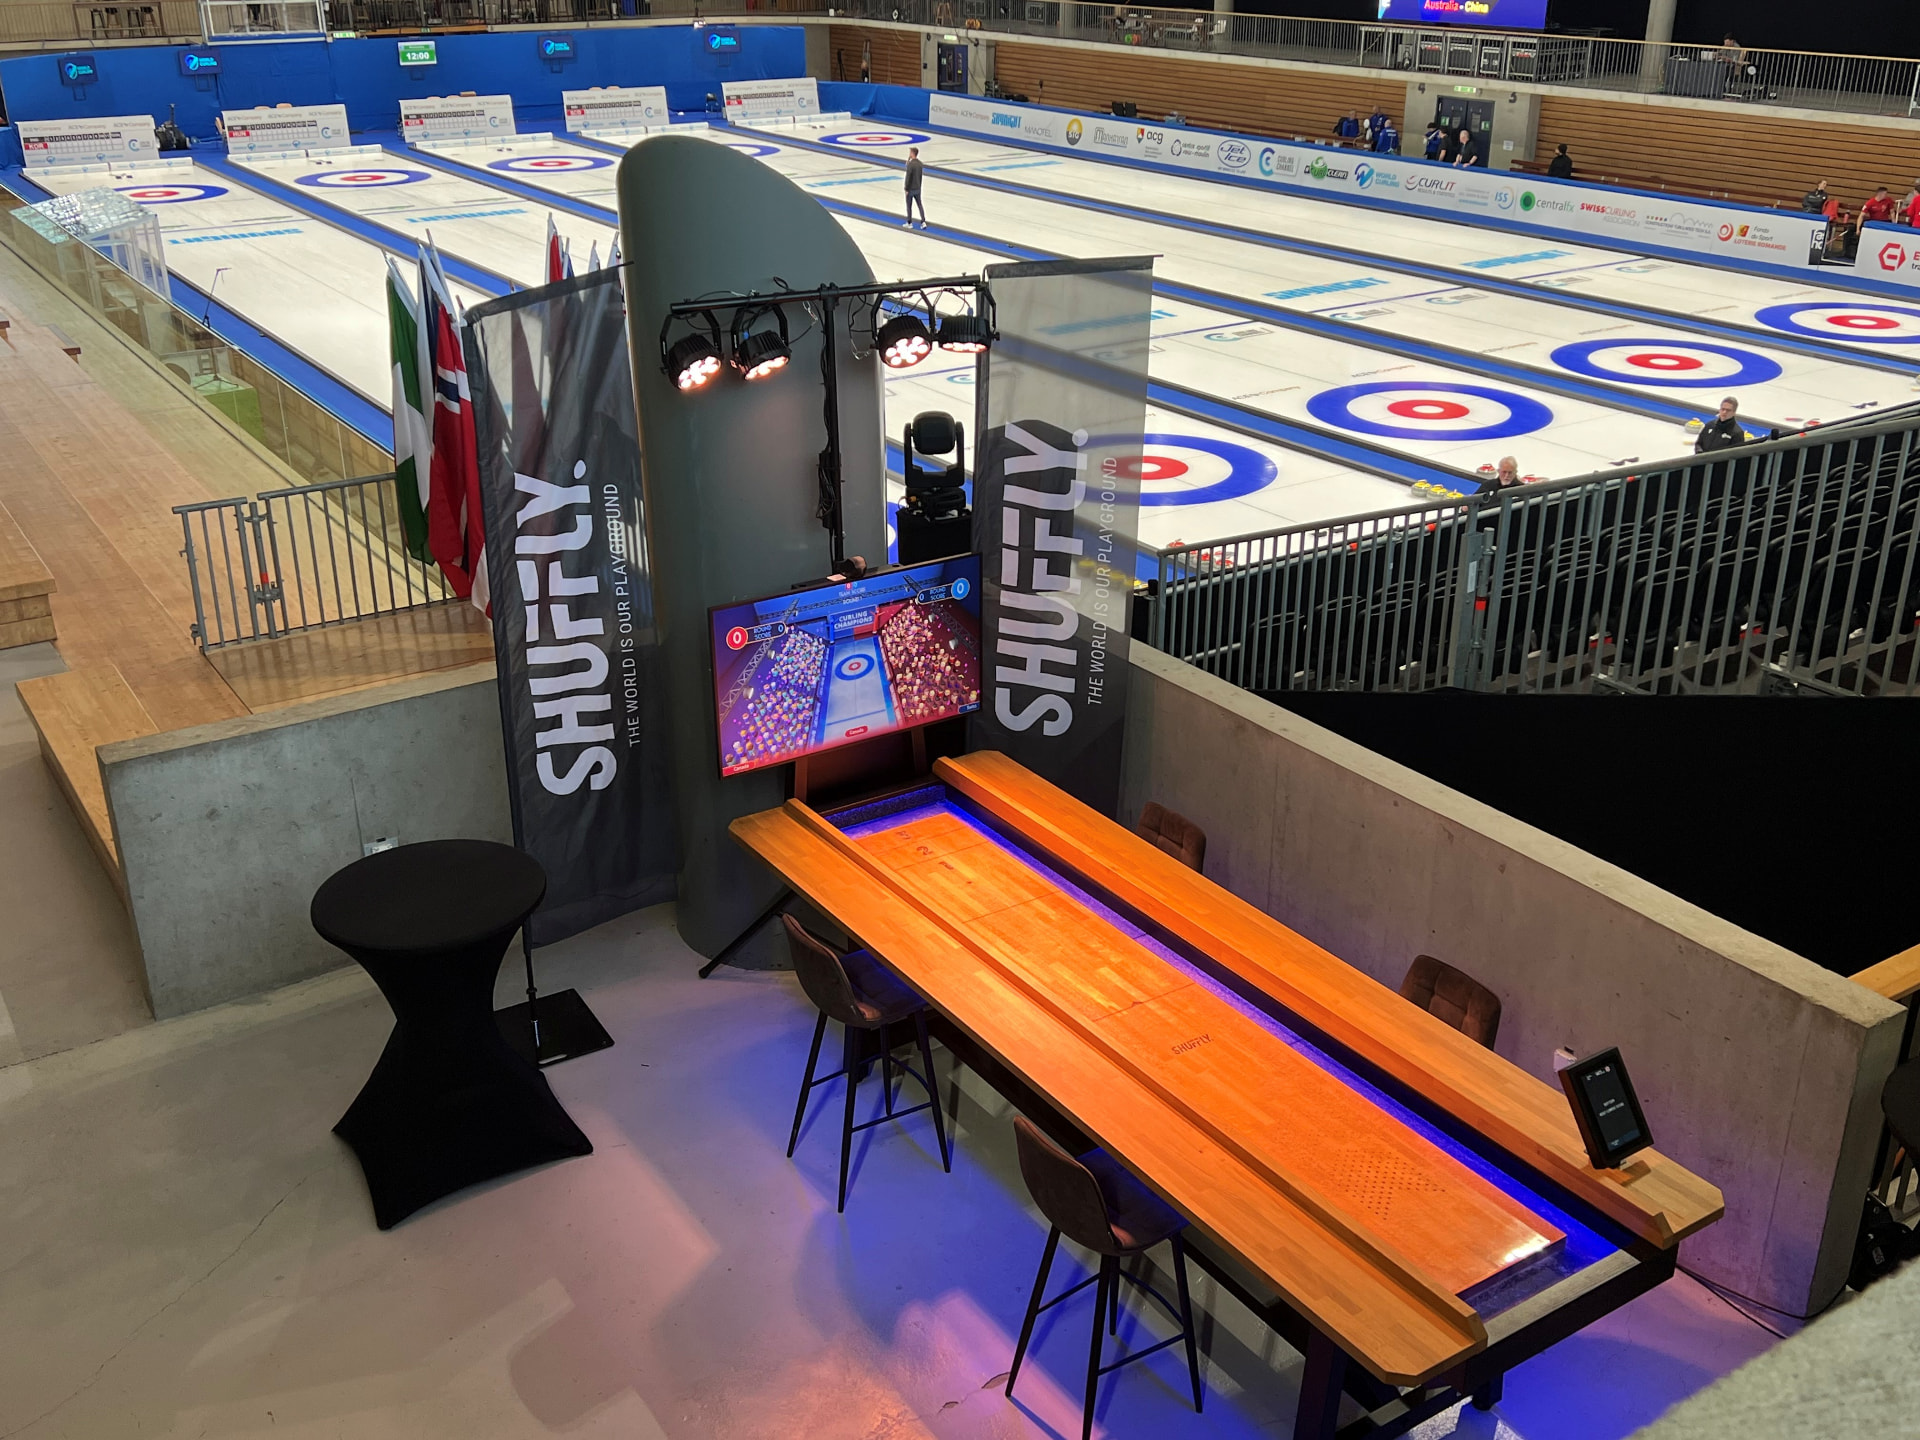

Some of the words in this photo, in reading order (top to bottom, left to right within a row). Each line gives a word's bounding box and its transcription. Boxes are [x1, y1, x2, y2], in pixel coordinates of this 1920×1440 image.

[1424, 0, 1460, 11] Australia
[1464, 1, 1490, 13] China
[406, 51, 430, 61] 12:00
[1147, 131, 1164, 144] acg
[1221, 144, 1246, 155] Jet
[1224, 154, 1247, 163] Ice
[1419, 177, 1456, 191] CURLIT
[1098, 457, 1118, 563] PLAYGROUND
[603, 483, 631, 598] PLAYGROUND
[1096, 569, 1111, 600] OUR
[617, 600, 633, 635] OUR
[838, 610, 868, 622] CURLING
[1094, 602, 1108, 621] IS
[834, 616, 873, 630] CHAMPIONS
[620, 637, 634, 653] IS
[1090, 625, 1107, 672] WORLD
[624, 658, 639, 715] WORLD
[1088, 677, 1104, 705] THE
[629, 716, 641, 748] THE
